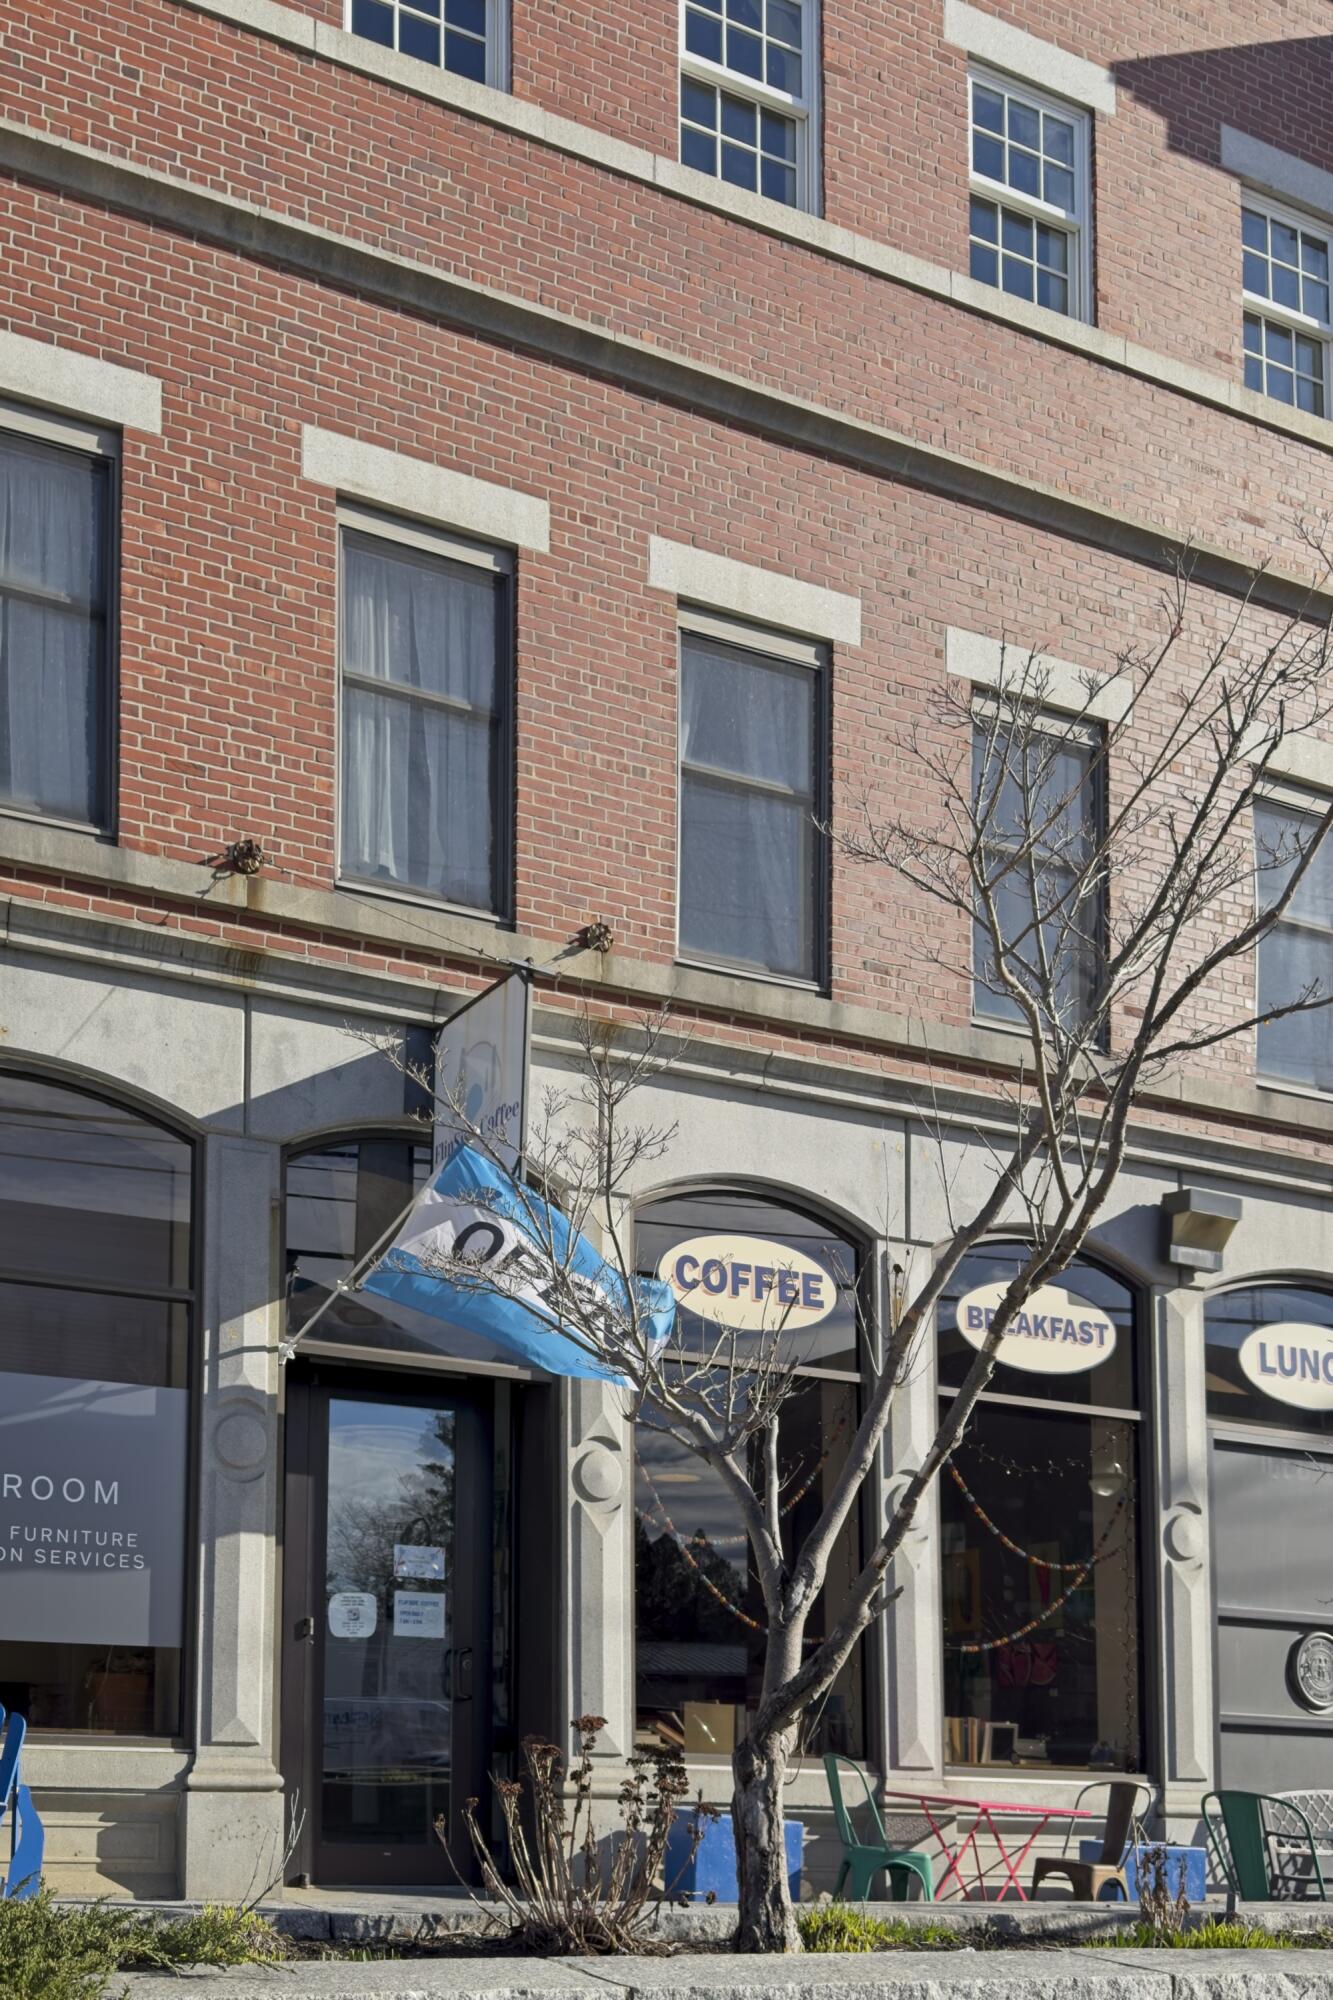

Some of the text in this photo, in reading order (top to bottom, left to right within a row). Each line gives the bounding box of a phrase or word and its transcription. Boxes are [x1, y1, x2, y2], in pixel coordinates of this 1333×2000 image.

[480, 1101, 519, 1135] Coffee
[674, 1254, 825, 1310] COFFEE
[966, 1305, 1109, 1346] BRAKFAST
[3, 1473, 119, 1505] ROOM
[9, 1525, 138, 1548] FURNITURE
[34, 1548, 145, 1570] SERVICES
